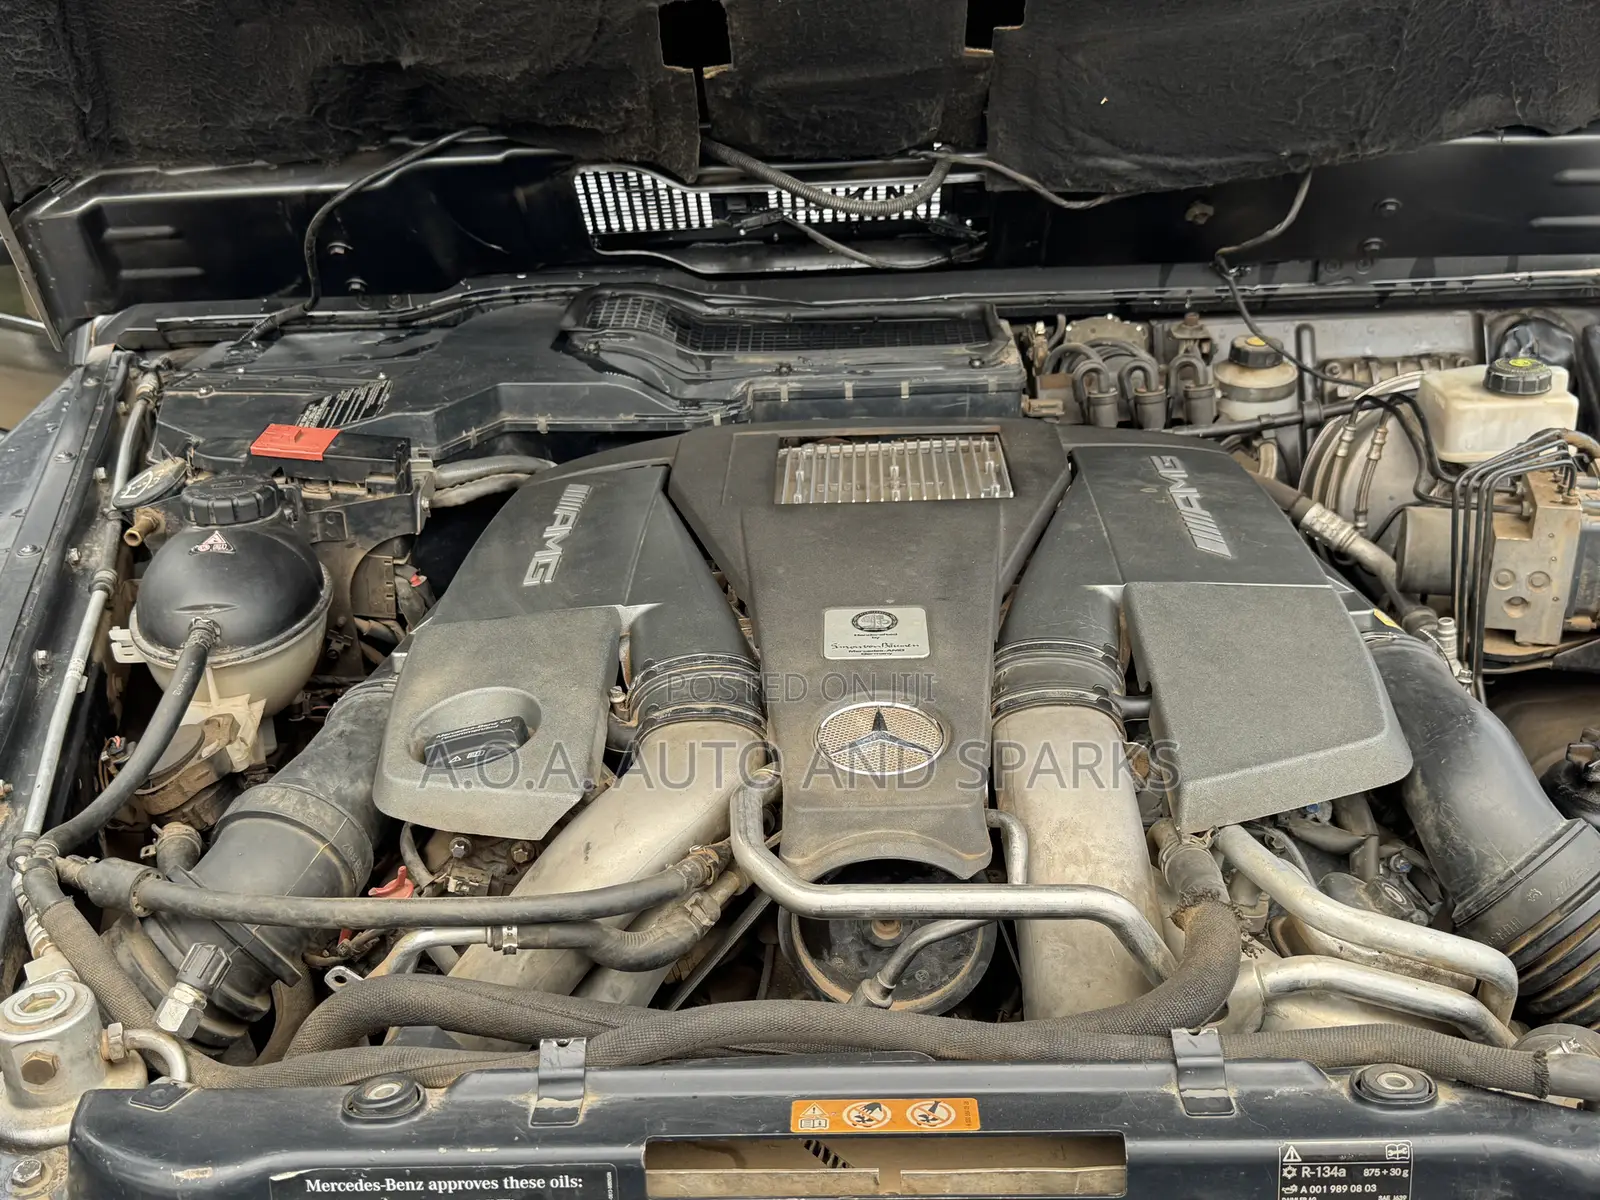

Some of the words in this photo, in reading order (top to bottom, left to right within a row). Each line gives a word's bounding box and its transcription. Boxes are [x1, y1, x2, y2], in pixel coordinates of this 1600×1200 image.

[1150, 456, 1216, 526] AMG
[523, 504, 582, 586] AMG
[1301, 1166, 1347, 1178] R-134a
[1363, 1168, 1381, 1177] 875
[1389, 1168, 1402, 1177] 30
[305, 1178, 424, 1192] Mercedes-Benz
[428, 1179, 499, 1193] approves
[503, 1176, 546, 1189] these
[550, 1175, 583, 1188] oils:
[1300, 1185, 1308, 1194] A
[1309, 1185, 1327, 1194] 001
[1330, 1184, 1348, 1193] 989
[1350, 1184, 1362, 1193] 08
[1364, 1184, 1377, 1192] 03
